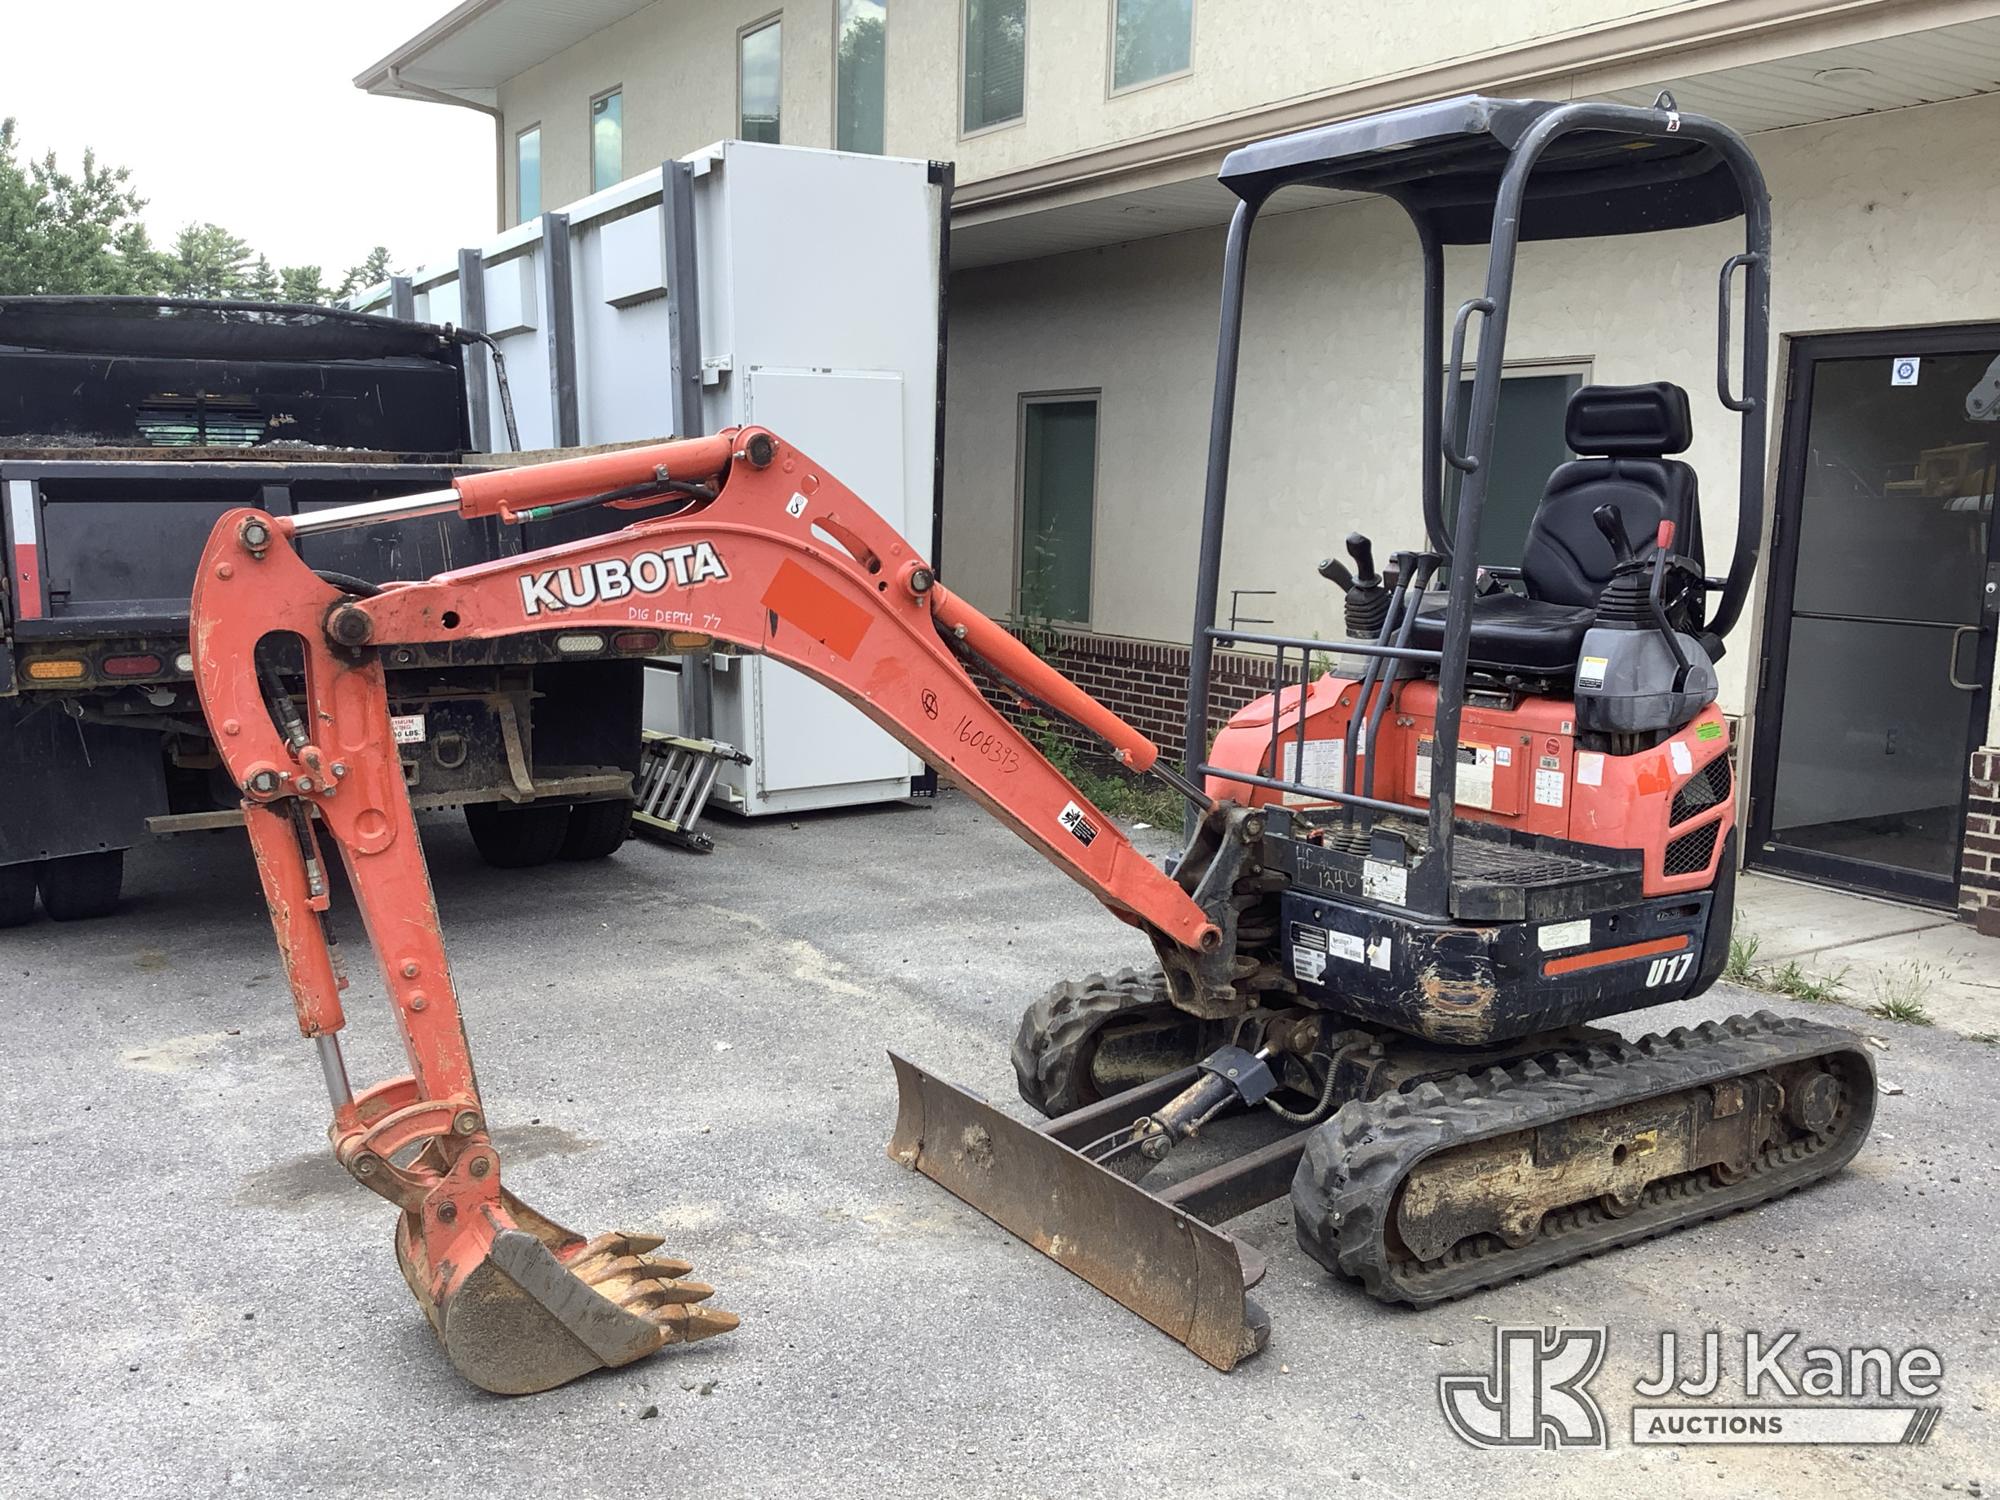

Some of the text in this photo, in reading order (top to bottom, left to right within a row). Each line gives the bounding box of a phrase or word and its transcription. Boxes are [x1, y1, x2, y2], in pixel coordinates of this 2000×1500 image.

[519, 541, 728, 615] KUBOTA
[628, 607, 649, 621] DIG
[655, 610, 693, 626] DEPTH
[953, 714, 1020, 774] 1608393
[1645, 952, 1695, 988] U17
